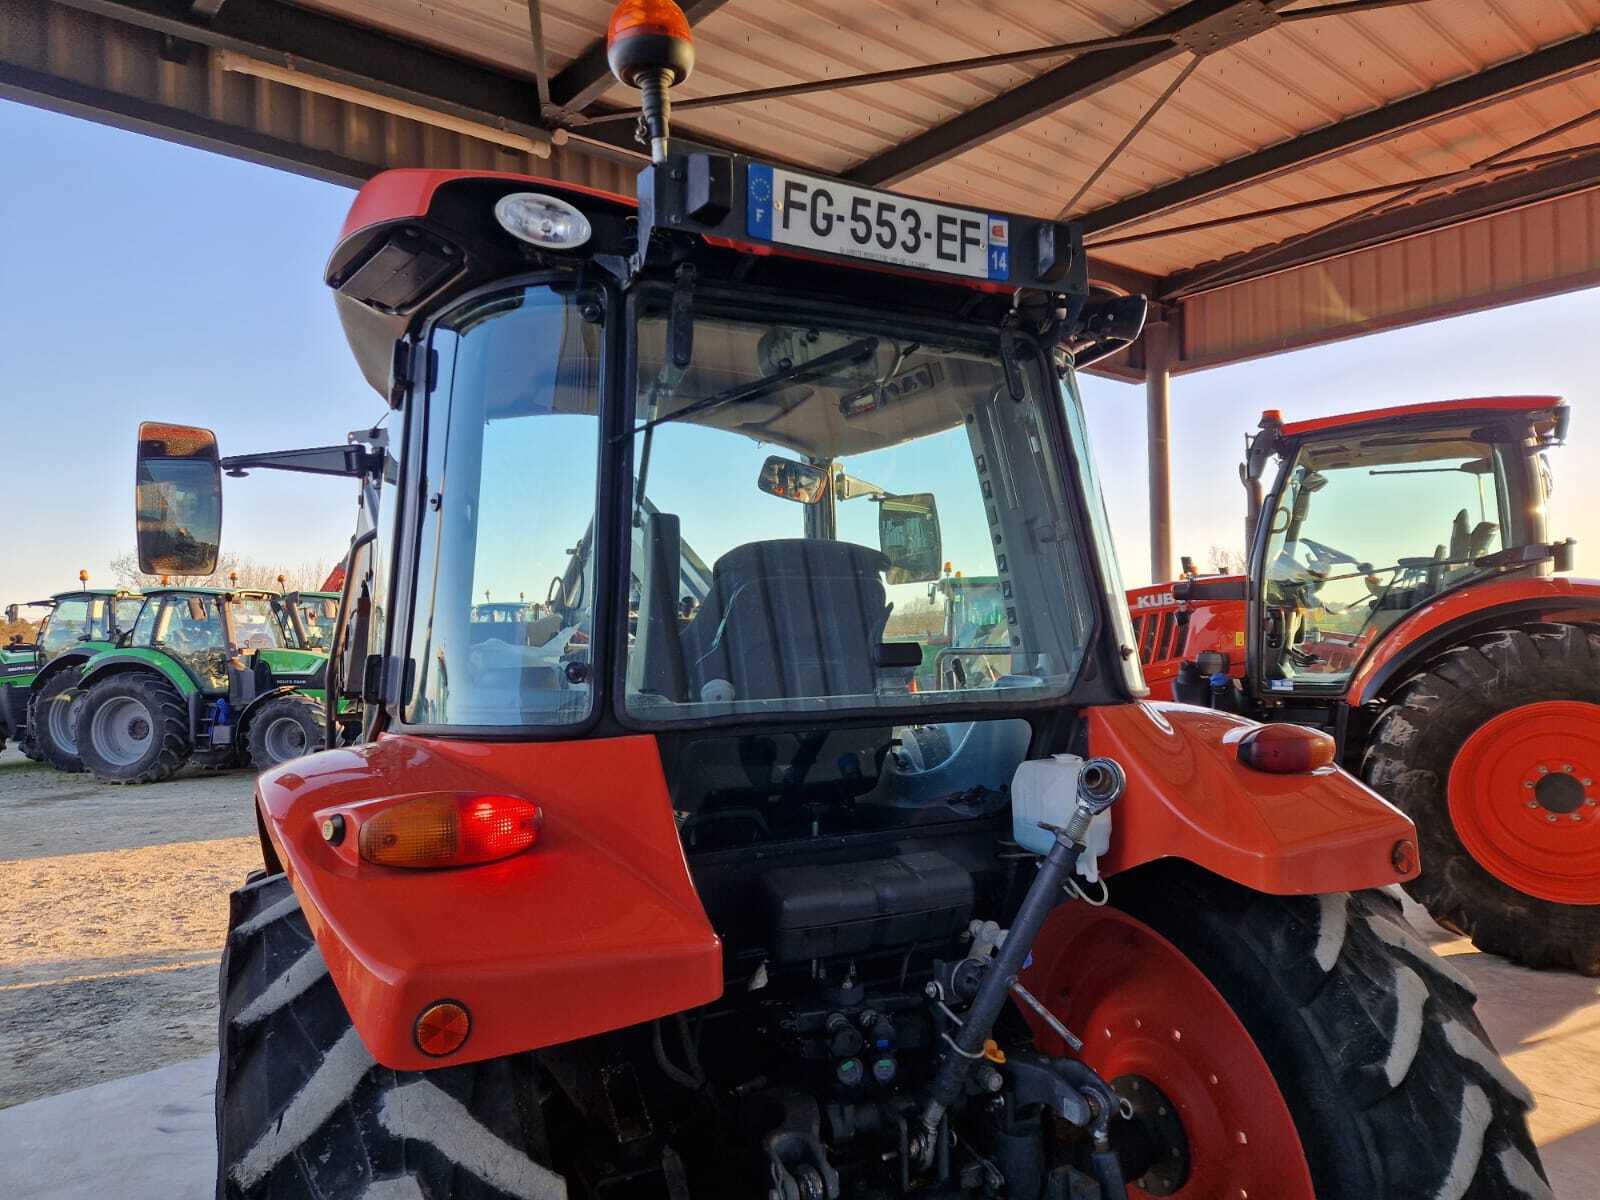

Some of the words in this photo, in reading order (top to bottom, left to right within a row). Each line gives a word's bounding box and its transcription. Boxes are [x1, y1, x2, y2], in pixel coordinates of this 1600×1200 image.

[756, 209, 765, 222] F
[783, 180, 980, 263] FG-553-EF
[992, 251, 1008, 271] 14
